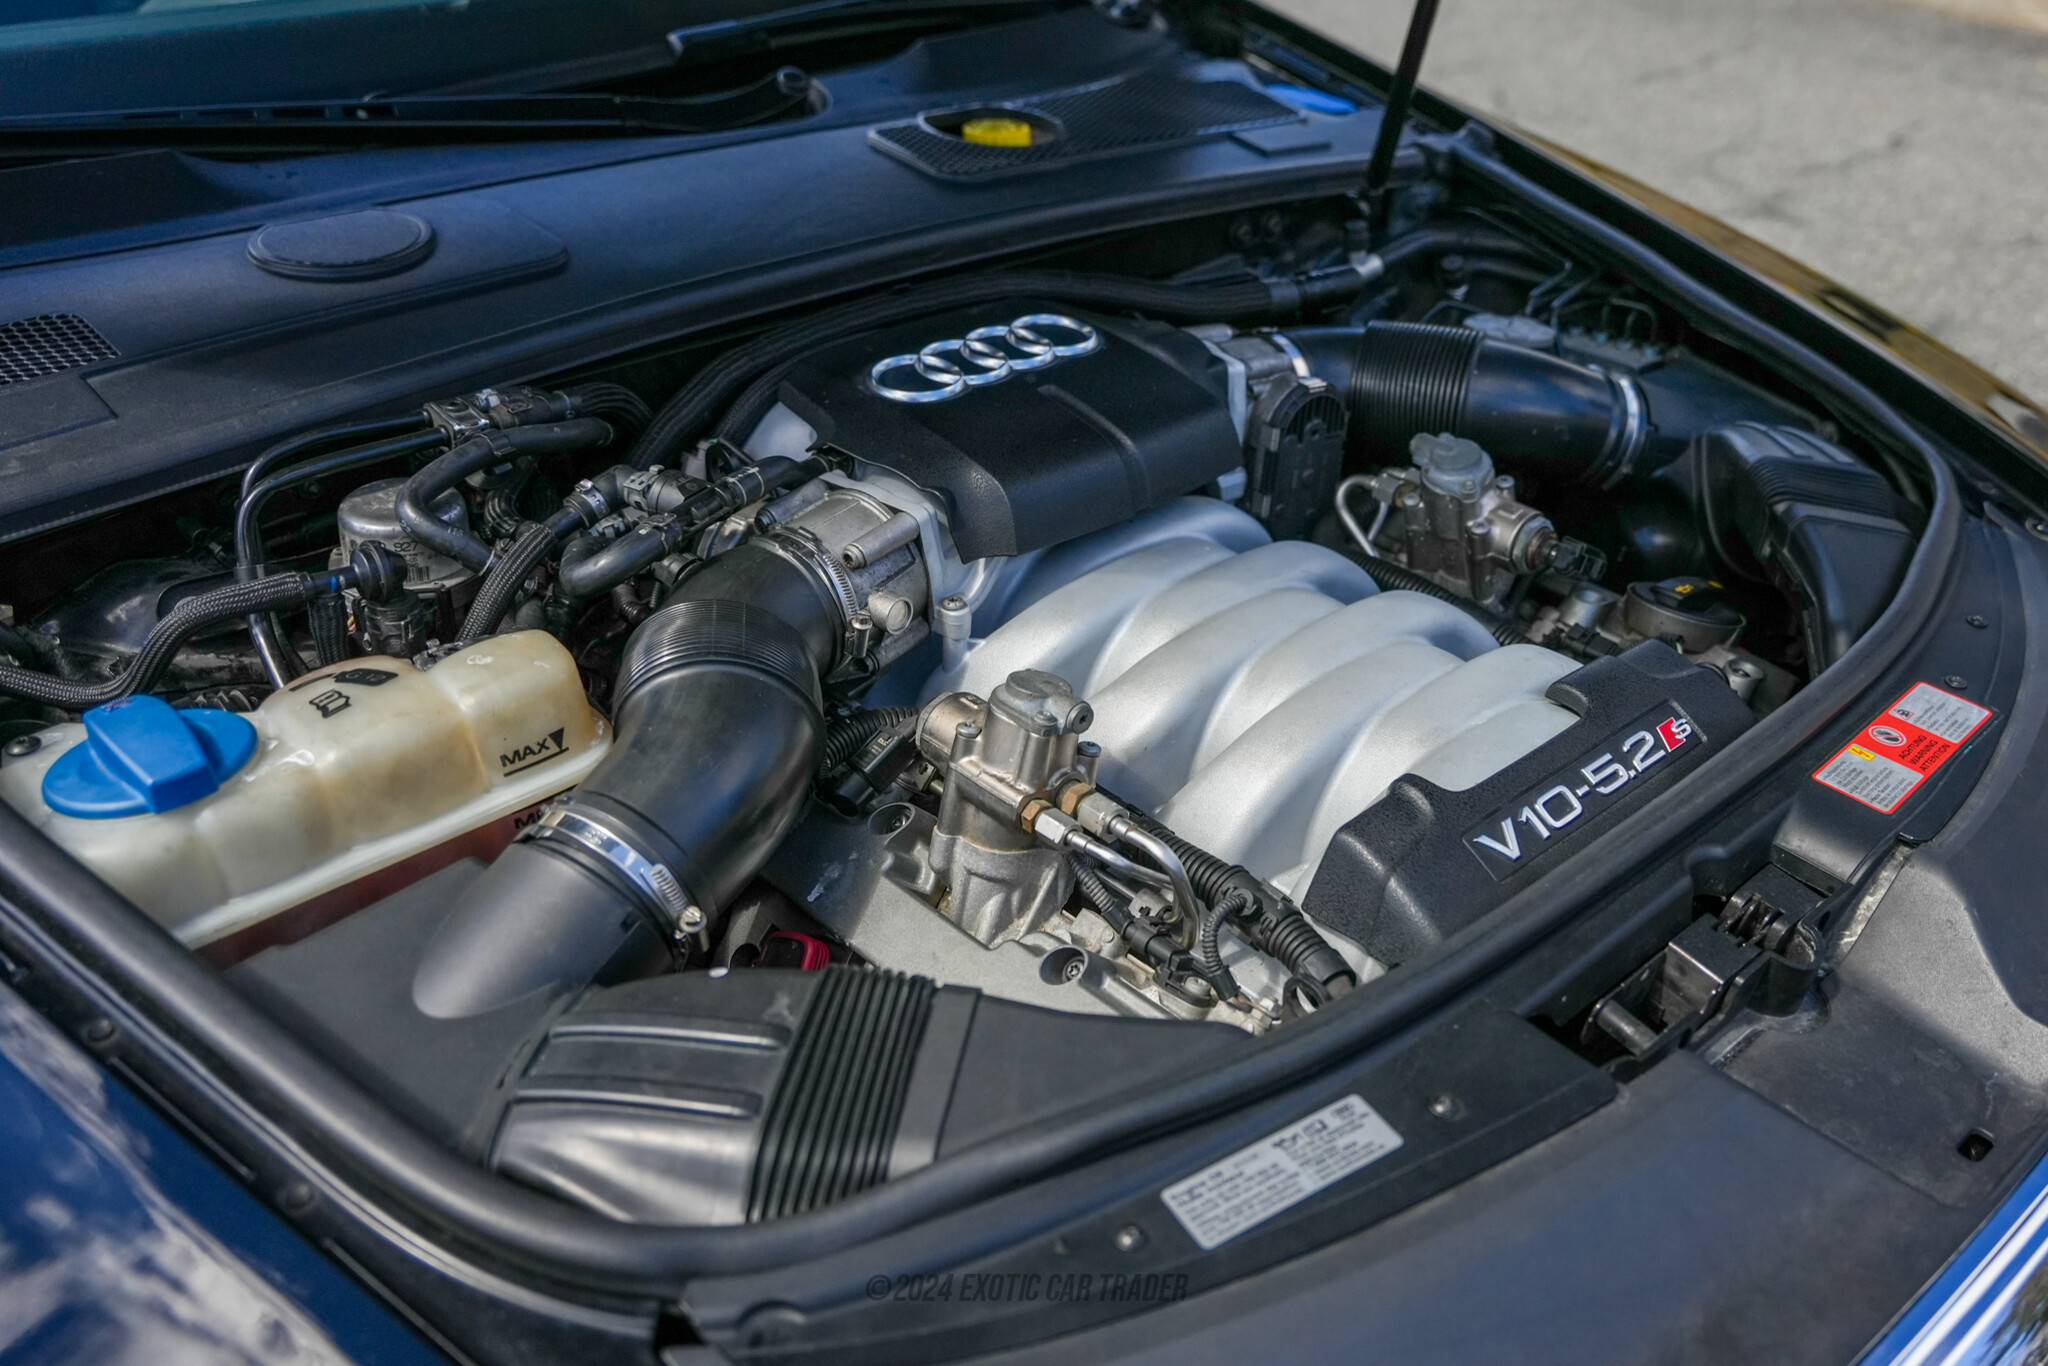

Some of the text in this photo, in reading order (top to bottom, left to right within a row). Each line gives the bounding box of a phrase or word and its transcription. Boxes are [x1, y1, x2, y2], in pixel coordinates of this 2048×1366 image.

[500, 737, 550, 768] MAX
[1899, 734, 1928, 760] ACHTUNG
[1909, 739, 1939, 765] WARNING
[1919, 743, 1951, 772] ATTENTION
[1473, 730, 1666, 862] V10-5.2
